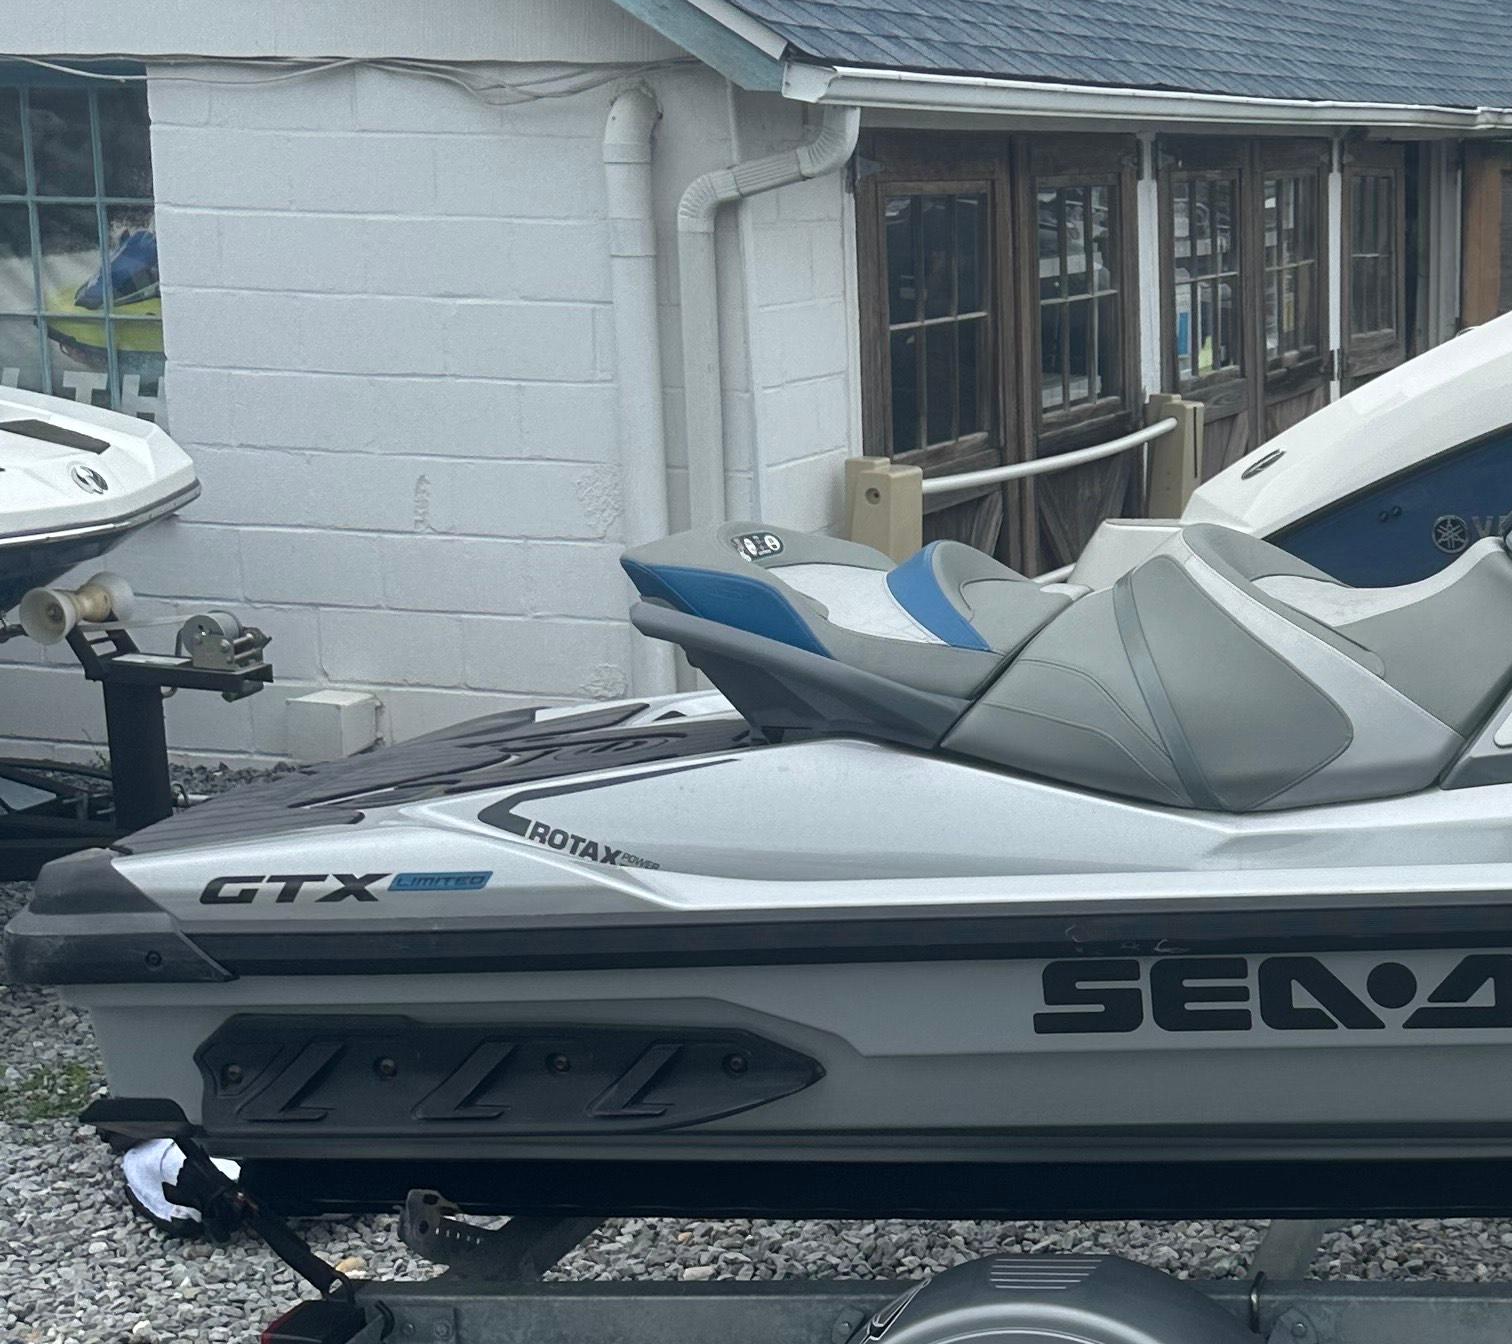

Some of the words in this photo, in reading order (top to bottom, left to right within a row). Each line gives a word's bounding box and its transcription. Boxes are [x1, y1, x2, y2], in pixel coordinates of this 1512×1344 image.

[528, 821, 622, 866] ROTAX
[620, 852, 661, 871] POWER
[199, 873, 392, 905] GTX
[396, 874, 486, 888] LIMITED
